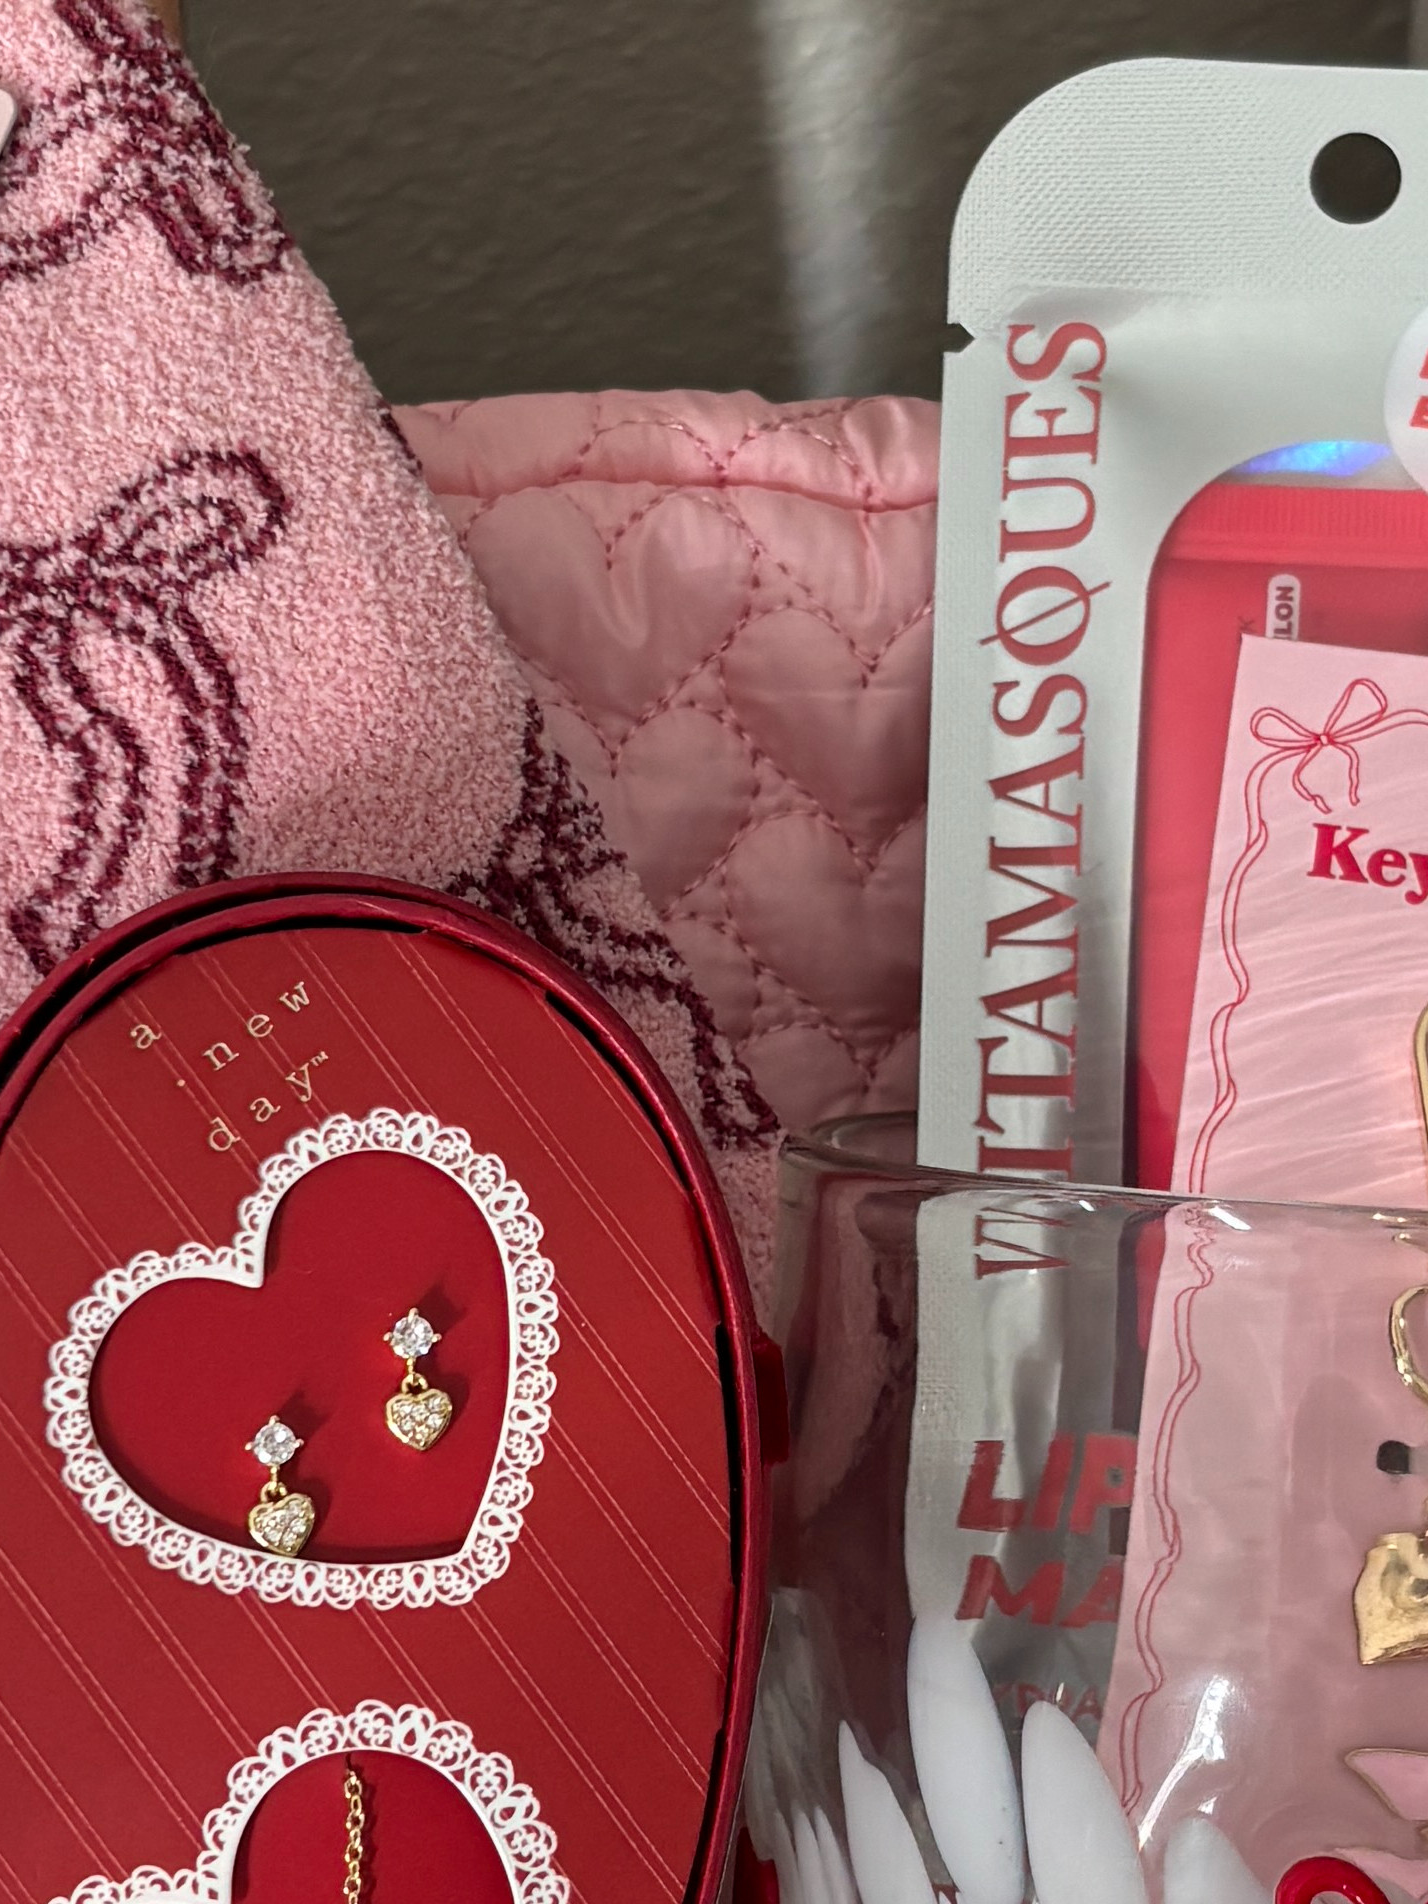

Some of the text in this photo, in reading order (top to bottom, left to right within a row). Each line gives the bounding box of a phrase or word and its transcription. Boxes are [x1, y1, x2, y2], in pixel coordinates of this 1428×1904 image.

[130, 1024, 162, 1049] a
[203, 981, 310, 1071] new
[957, 1435, 1138, 1534] LIP
